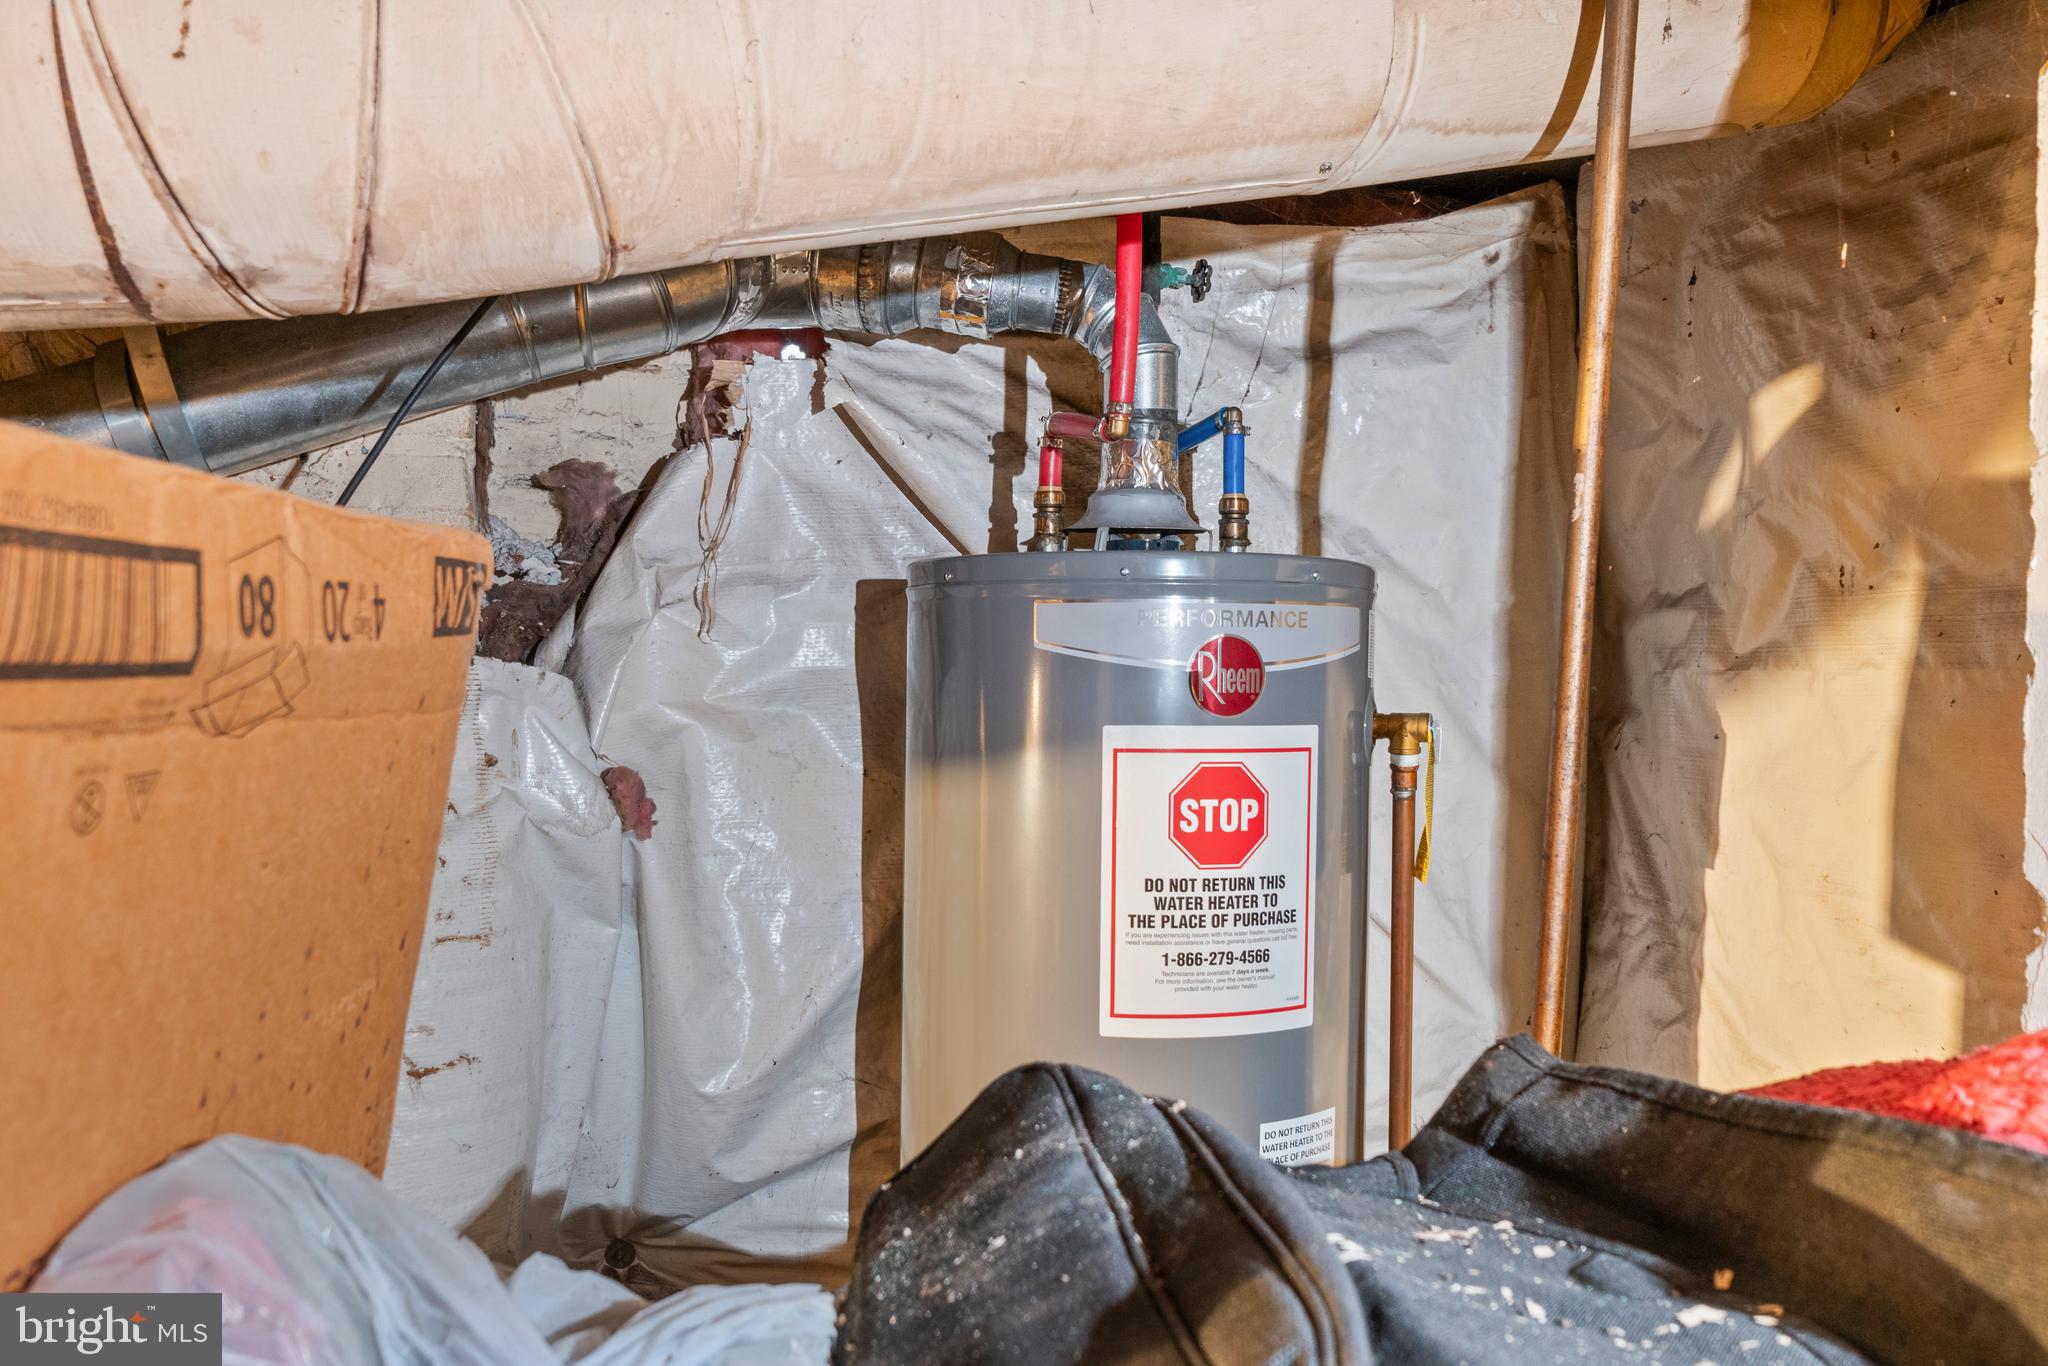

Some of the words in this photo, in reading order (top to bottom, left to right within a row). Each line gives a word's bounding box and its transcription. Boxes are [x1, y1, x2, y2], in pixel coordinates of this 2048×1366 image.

[239, 574, 275, 637] 80
[323, 580, 351, 642] 20
[1138, 609, 1309, 629] PERFORMANCE
[1199, 638, 1261, 704] Rheem
[1179, 798, 1259, 833] STOP
[1144, 878, 1164, 893] DO
[1169, 877, 1197, 893] NOT
[1202, 876, 1255, 892] RETURN
[1259, 874, 1286, 890] THIS
[1154, 896, 1203, 911] WATER
[1208, 894, 1259, 910] HEATER
[1263, 893, 1278, 908] TO
[1128, 914, 1155, 929] THE
[1161, 913, 1206, 929] PLACE
[1211, 912, 1229, 928] OF
[1233, 909, 1297, 927] PURCHASE
[1162, 948, 1270, 966] 1-866-279-4566
[1206, 969, 1231, 977] available
[1236, 968, 1250, 976] days
[1174, 985, 1199, 993] provided
[1264, 1130, 1276, 1140] DO
[1278, 1127, 1294, 1138] NOT
[1295, 1121, 1320, 1135] RETURN
[1321, 1117, 1333, 1127] THIS
[1262, 1142, 1288, 1153] WATER
[1289, 1135, 1314, 1149] HEATER
[1315, 1132, 1323, 1141] TO
[1323, 1128, 1334, 1139] THE
[1290, 1151, 1300, 1162] OF
[1300, 1143, 1331, 1158] PURCHASE
